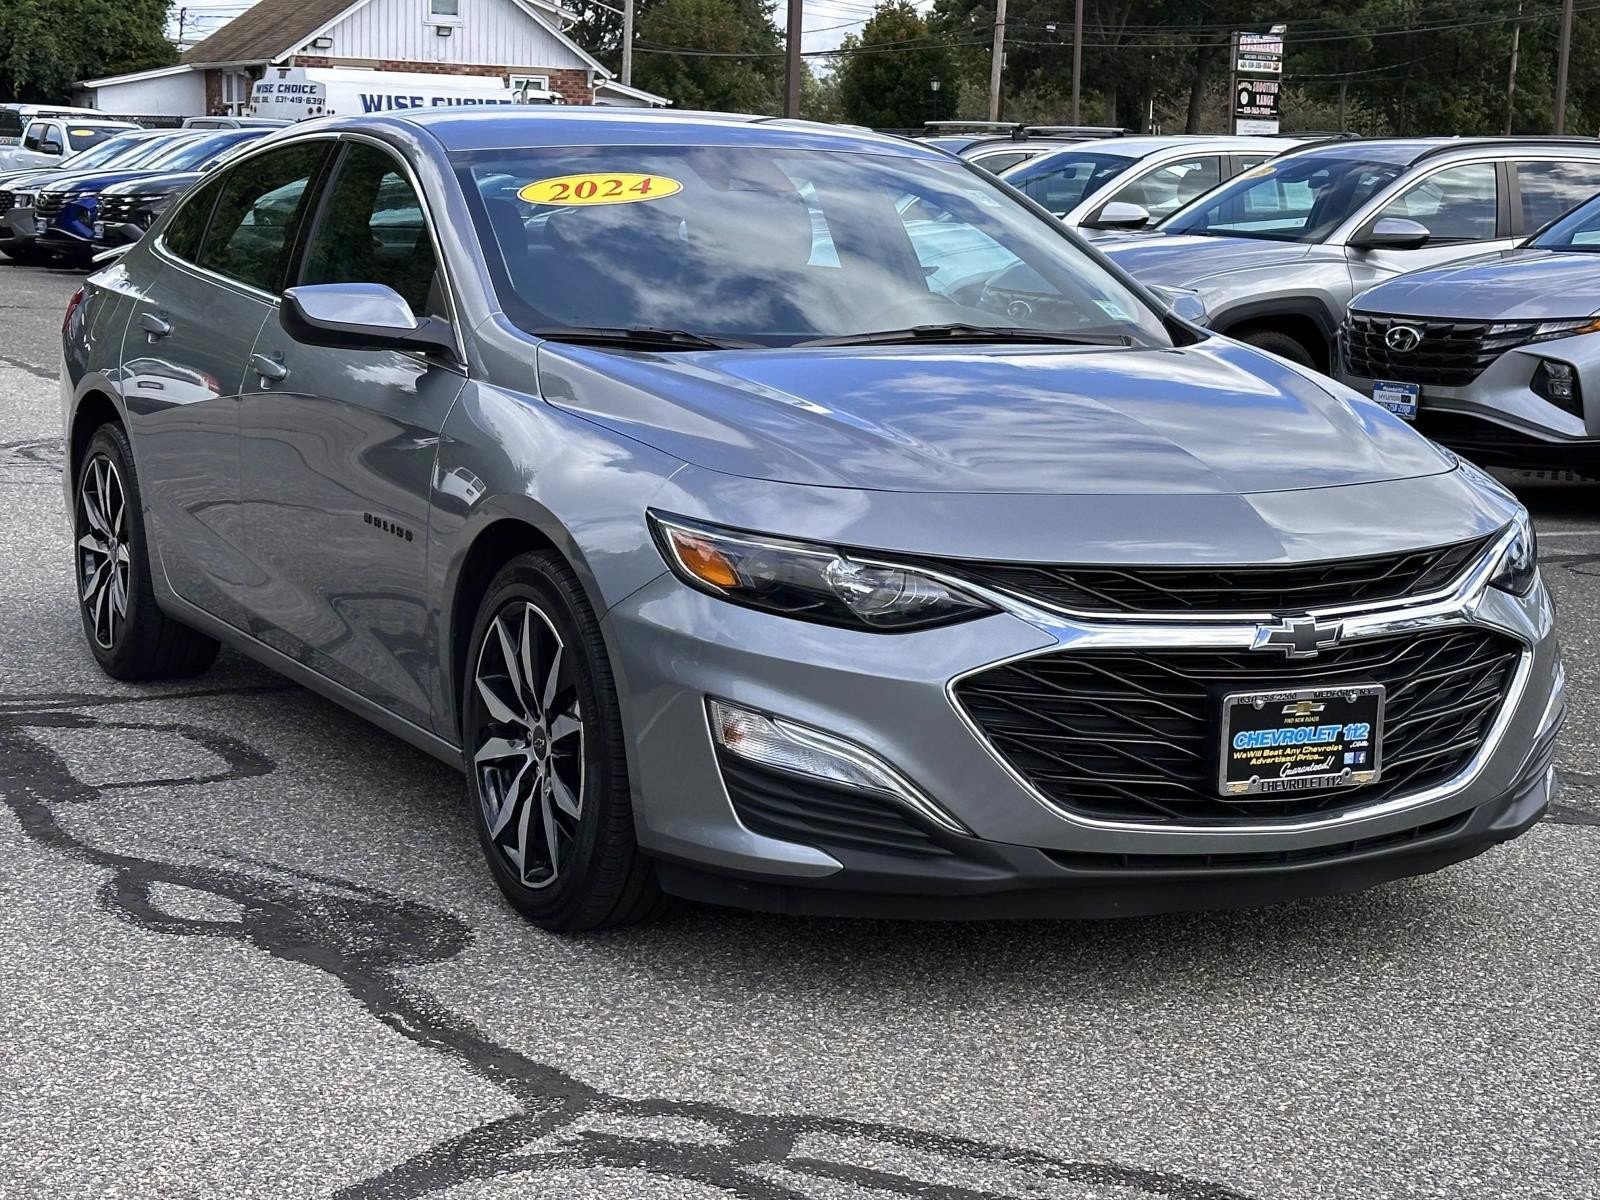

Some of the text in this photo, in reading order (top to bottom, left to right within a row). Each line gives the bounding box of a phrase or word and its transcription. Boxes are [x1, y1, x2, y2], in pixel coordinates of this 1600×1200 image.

[256, 84, 317, 94] WISE CHOICE
[1256, 94, 1274, 106] RANGE
[548, 178, 652, 202] 2024
[1233, 722, 1370, 750] CHEVROLET 112
[1349, 740, 1369, 748] .com
[1262, 749, 1283, 757] Beat
[1284, 747, 1301, 755] Any
[1302, 744, 1343, 753] Chevrolet
[1249, 755, 1297, 765] Advertised
[1261, 775, 1342, 792] CHEVROLET 112
